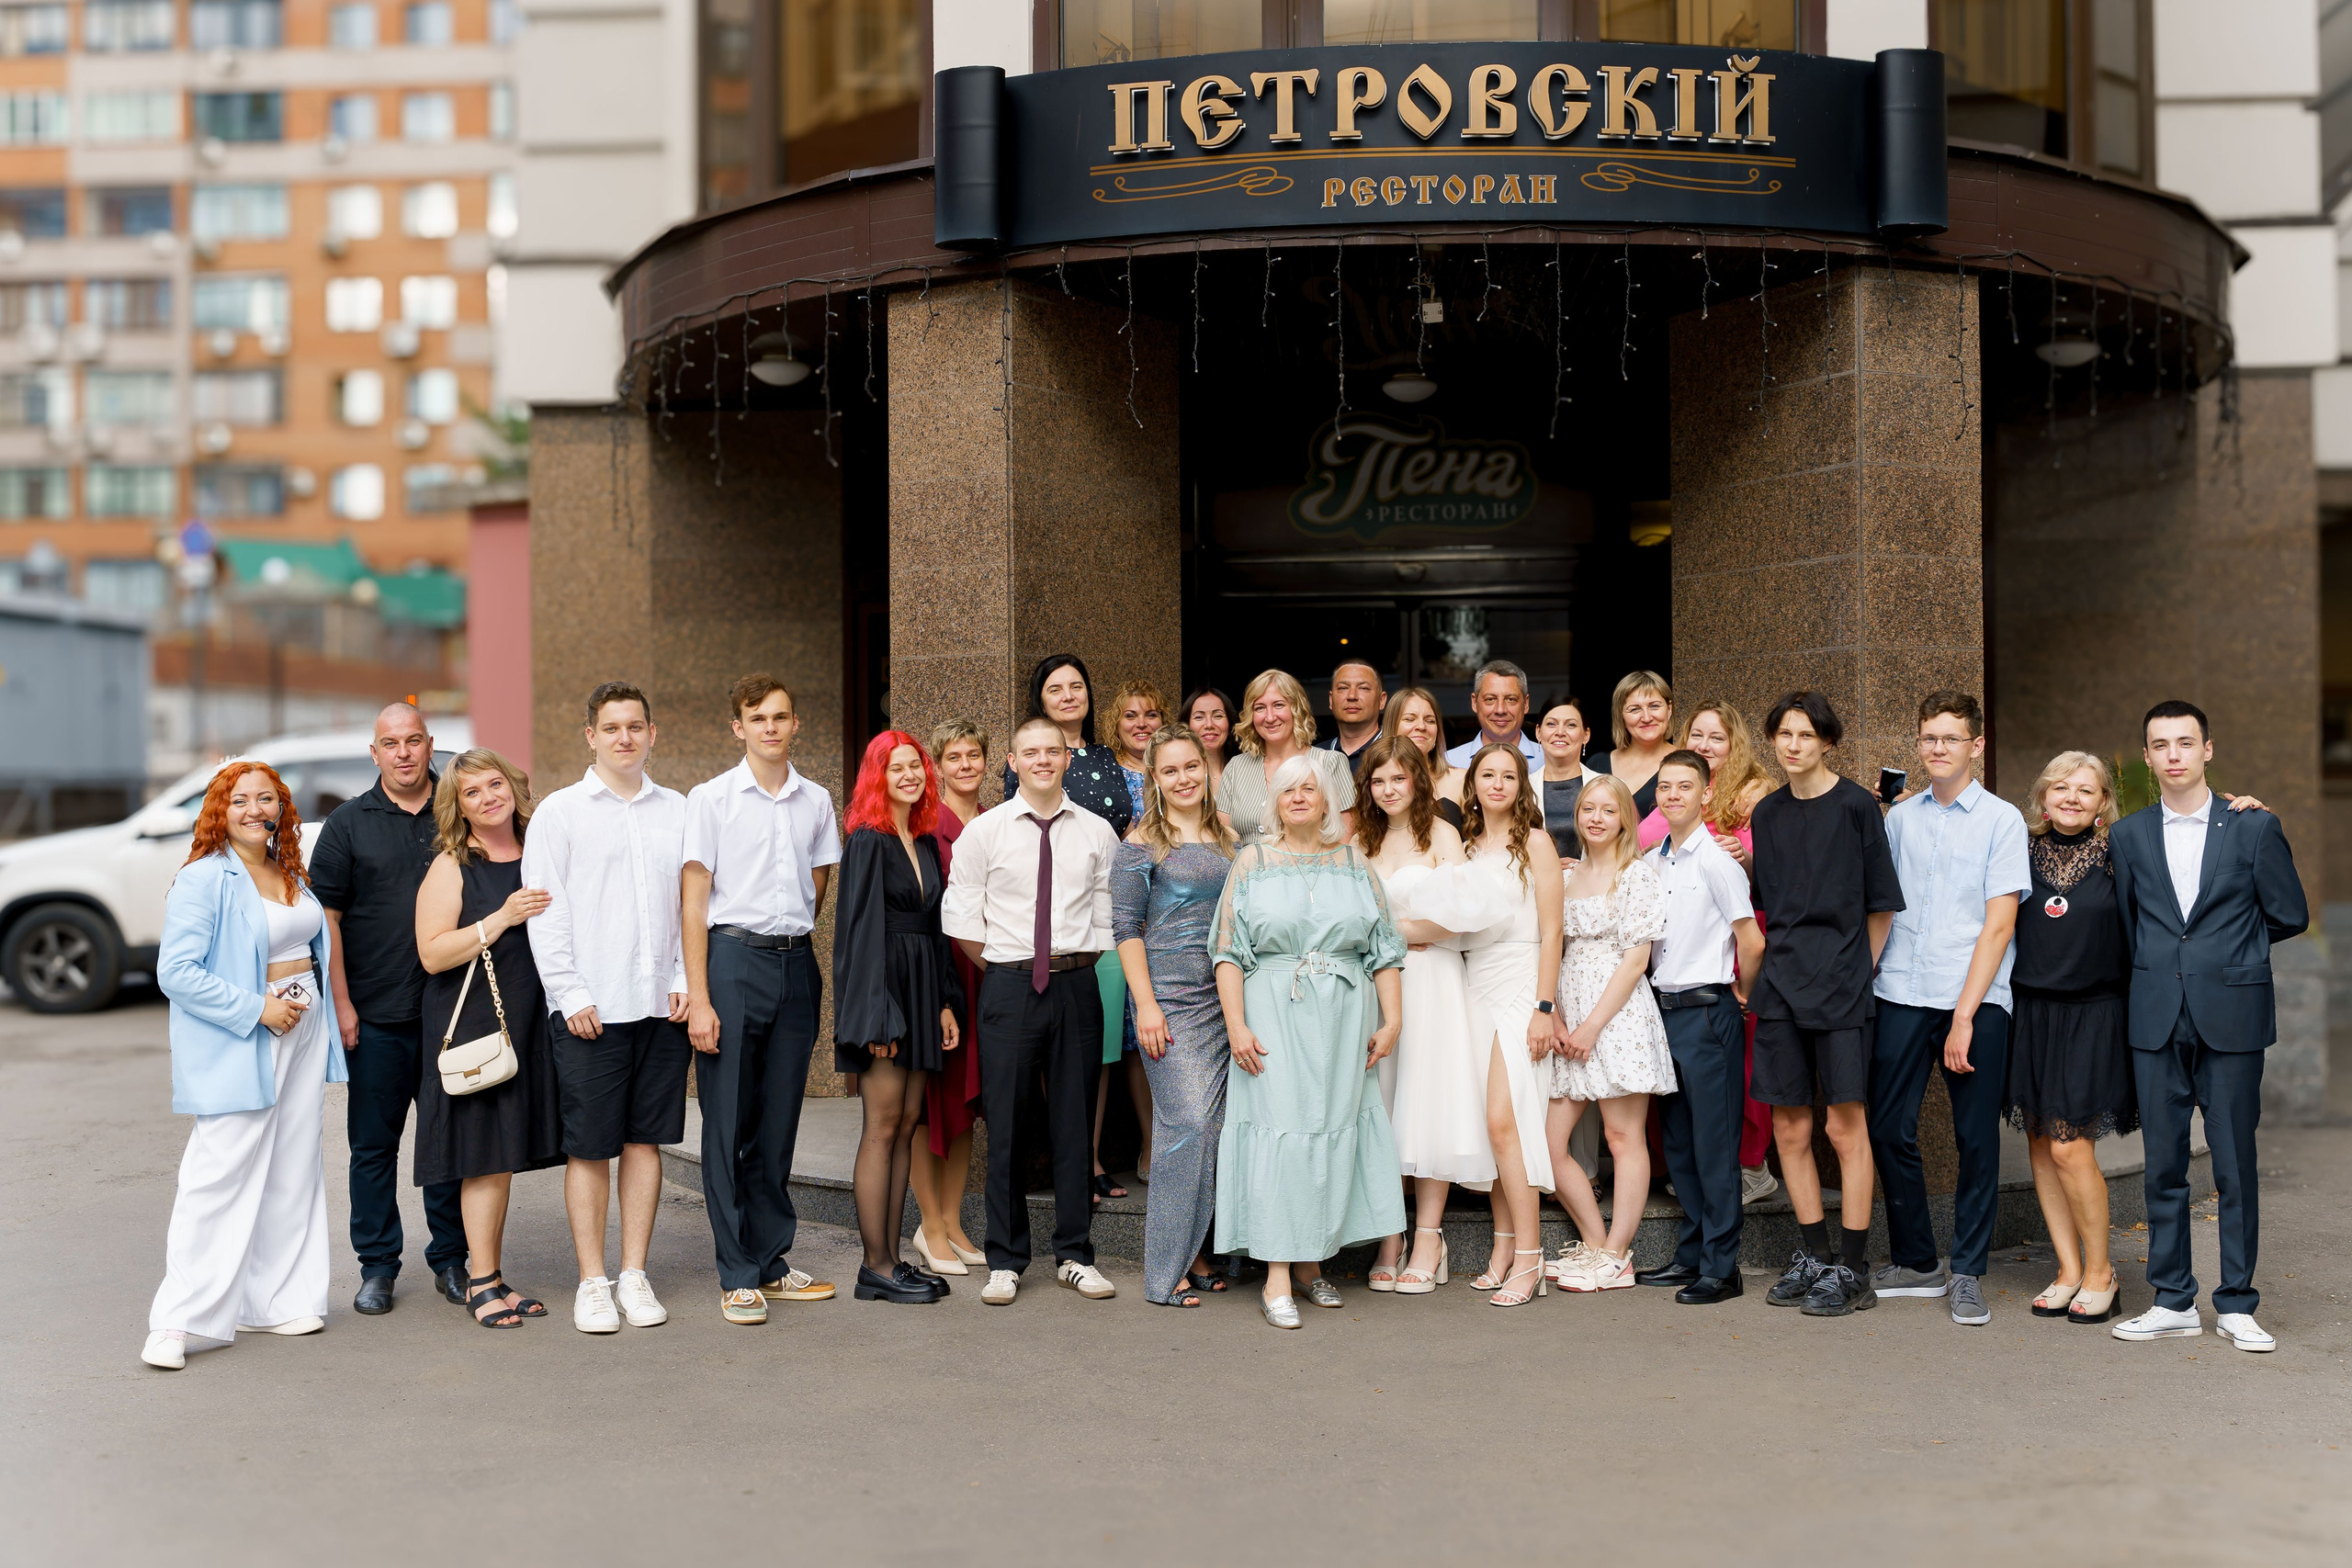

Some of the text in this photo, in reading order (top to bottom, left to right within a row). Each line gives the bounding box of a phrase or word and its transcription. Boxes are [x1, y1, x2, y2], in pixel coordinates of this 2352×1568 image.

[1321, 174, 1558, 209] РЕСТОРАН
[1299, 422, 1525, 526] Пена
[1378, 502, 1508, 523] РЕСТОРАН
